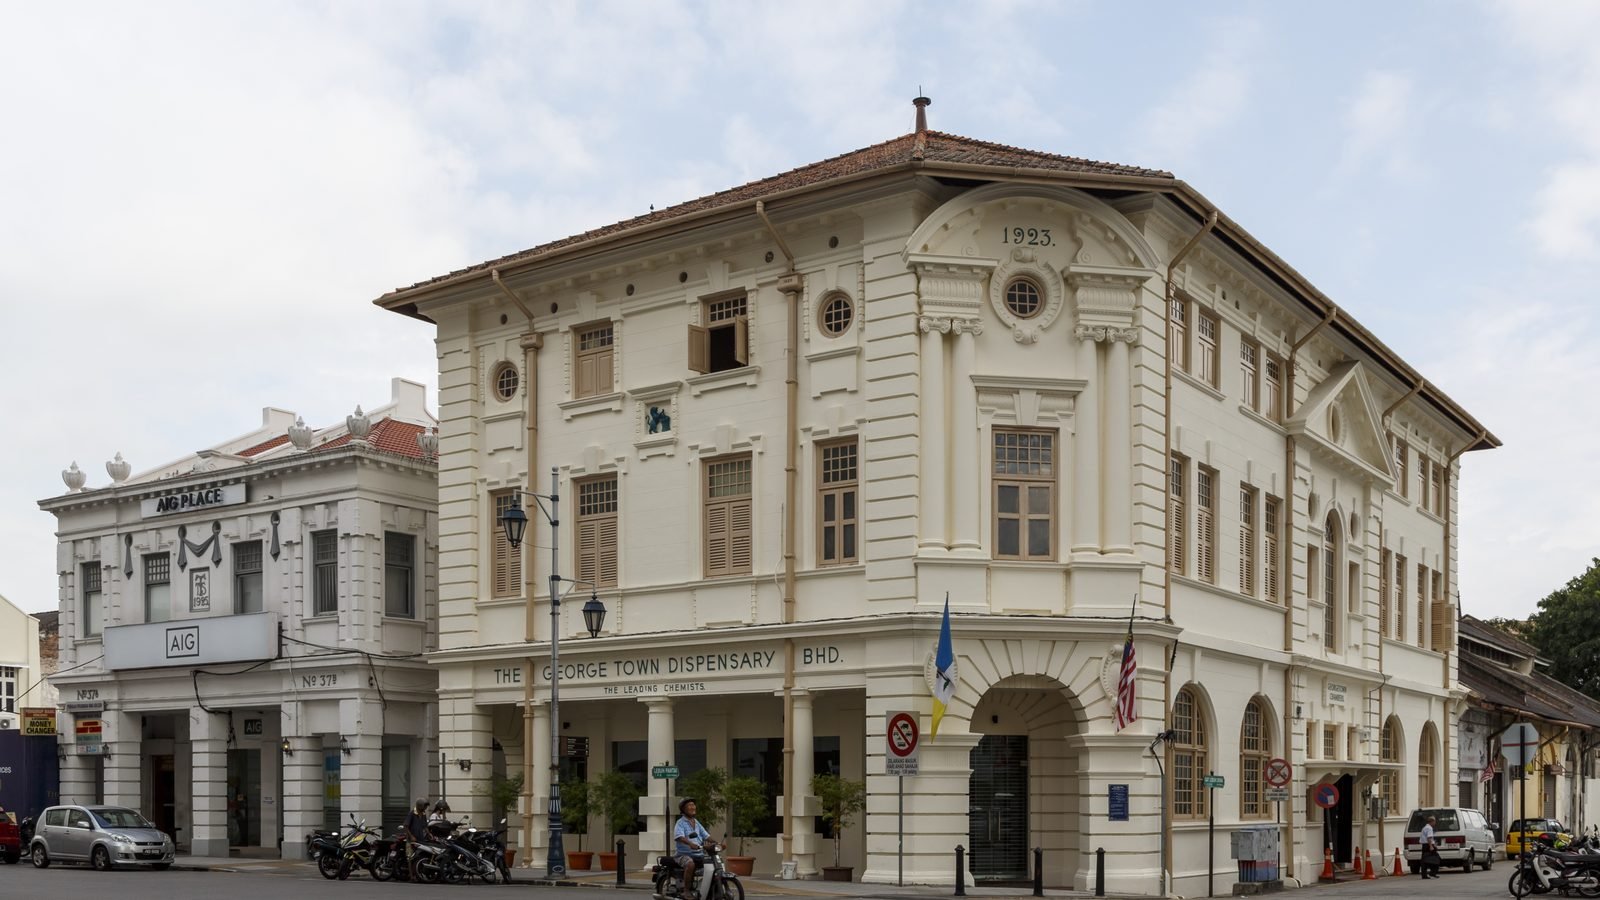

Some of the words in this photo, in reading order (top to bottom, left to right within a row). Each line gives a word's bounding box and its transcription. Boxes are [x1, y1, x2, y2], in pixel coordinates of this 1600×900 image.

[1002, 227, 1056, 247] 1923.
[156, 496, 179, 512] AIG
[180, 488, 224, 508] PLACE
[170, 633, 195, 652] AIG
[494, 668, 521, 684] THE
[542, 662, 607, 681] GEORGE
[614, 658, 660, 677] TOWN
[668, 650, 776, 673] DISPENSARY
[803, 646, 844, 665] BHD.
[624, 685, 658, 694] LEADING
[246, 721, 263, 734] AIG
